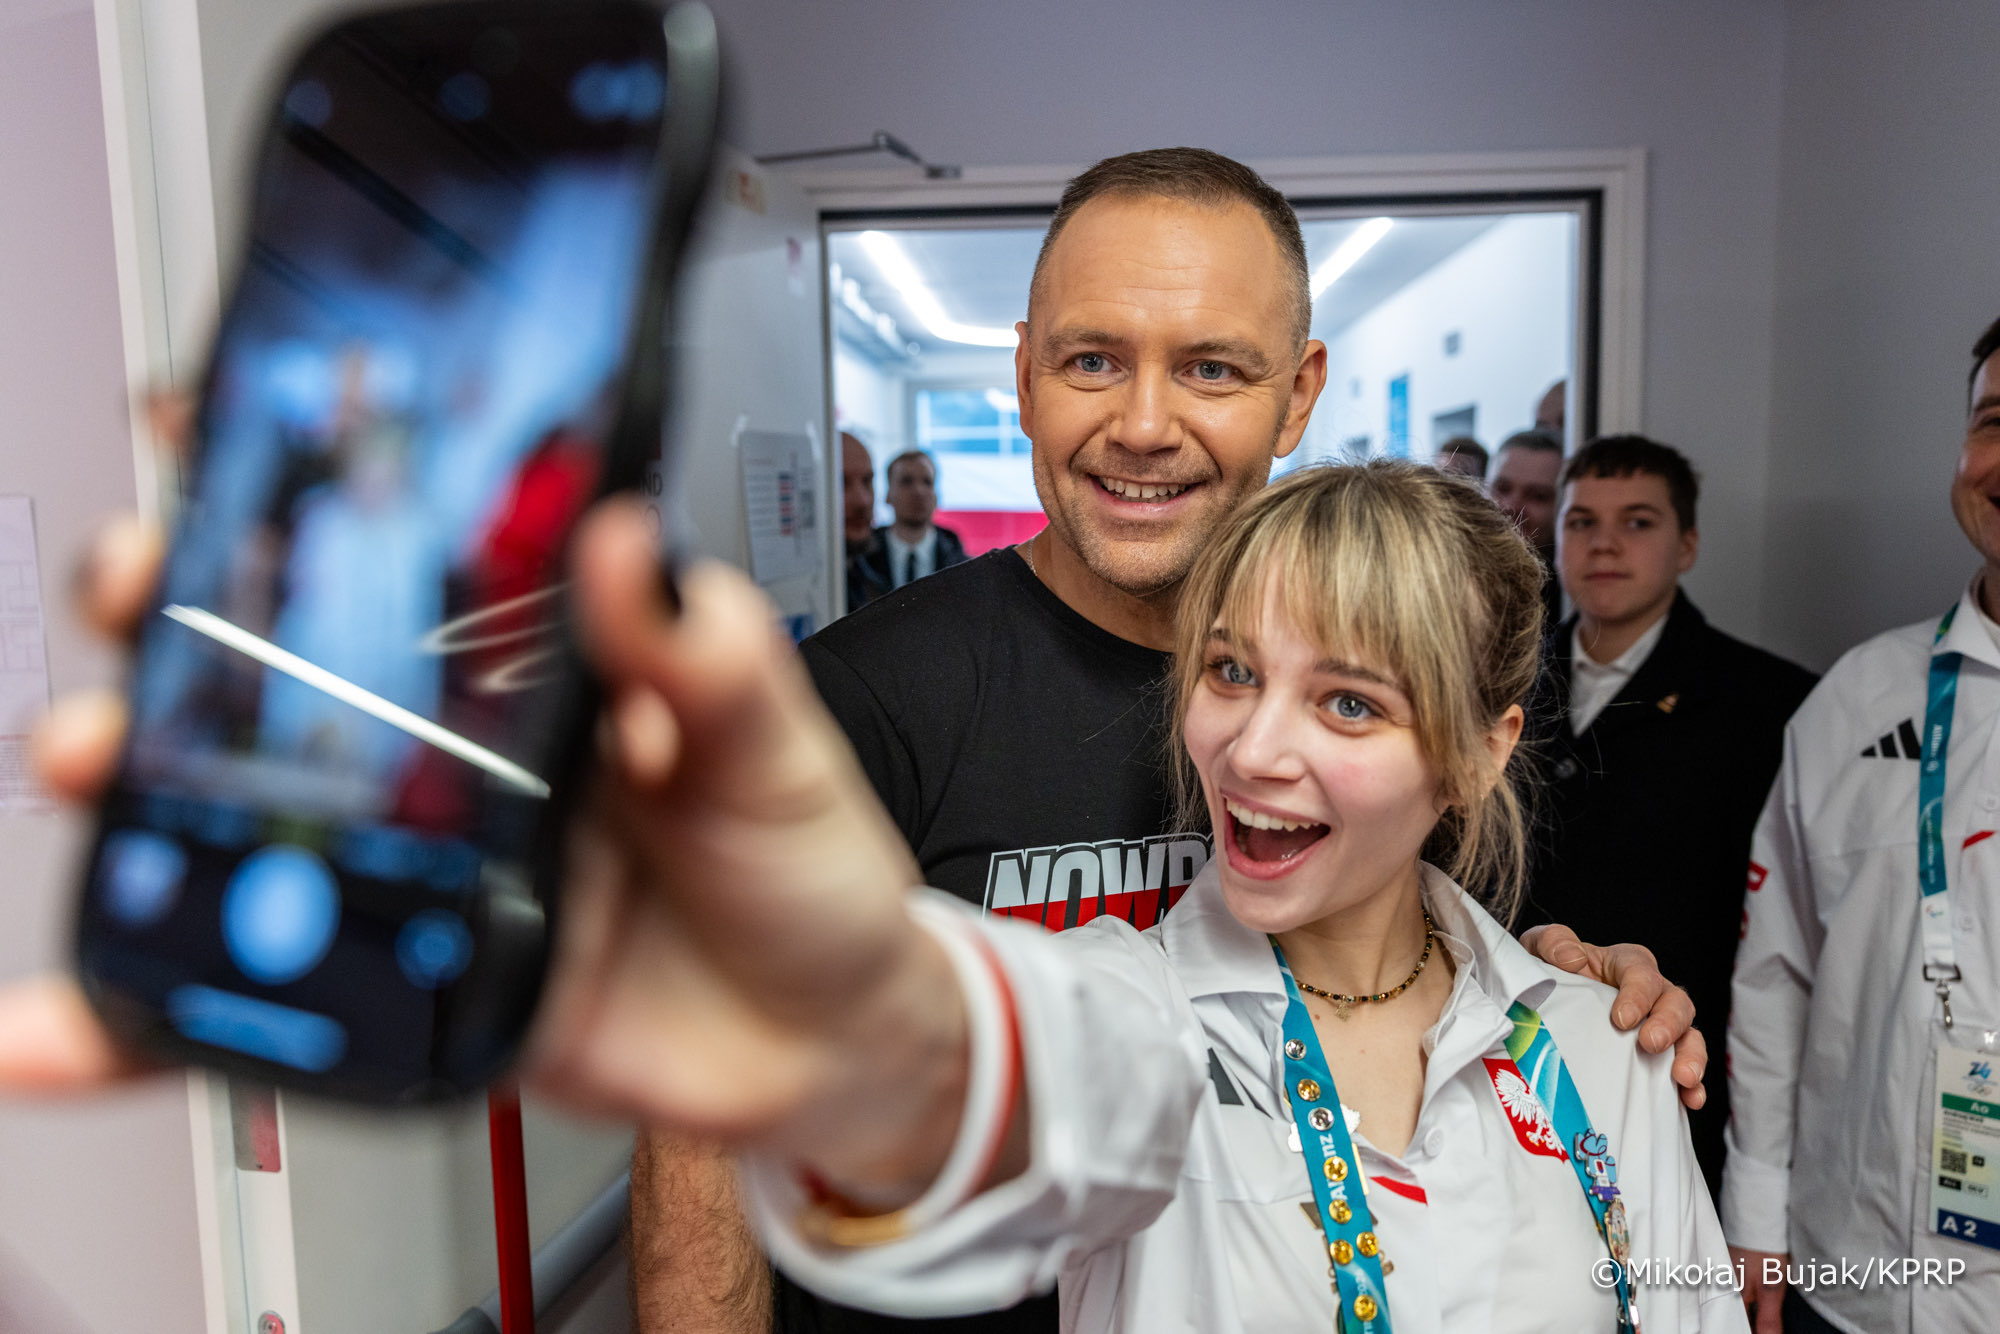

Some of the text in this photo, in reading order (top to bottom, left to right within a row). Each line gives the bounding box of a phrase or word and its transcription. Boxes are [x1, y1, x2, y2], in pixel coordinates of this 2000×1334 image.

[983, 832, 1216, 931] NOWR
[1319, 1133, 1349, 1201] Alnz
[1942, 1215, 1978, 1238] A 2
